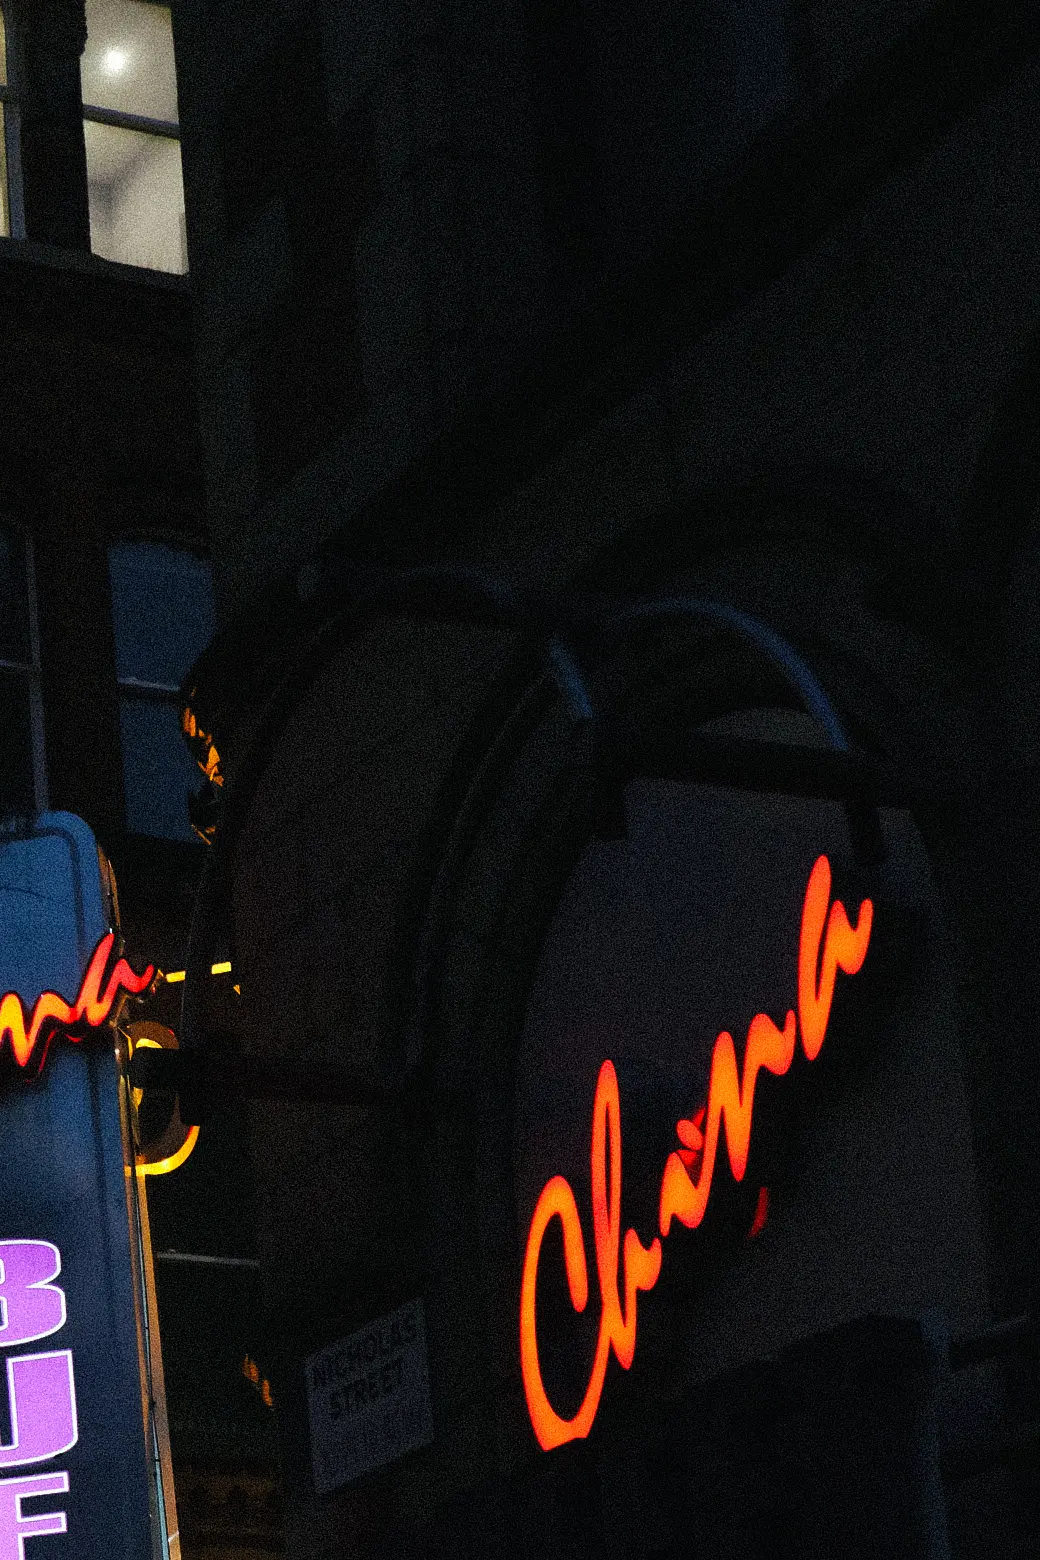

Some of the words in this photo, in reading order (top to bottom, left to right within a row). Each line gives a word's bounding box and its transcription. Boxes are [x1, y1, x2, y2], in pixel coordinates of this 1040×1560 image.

[520, 853, 874, 1453] China
[311, 1312, 419, 1389] NICHOLAS
[329, 1356, 405, 1420] STREET
